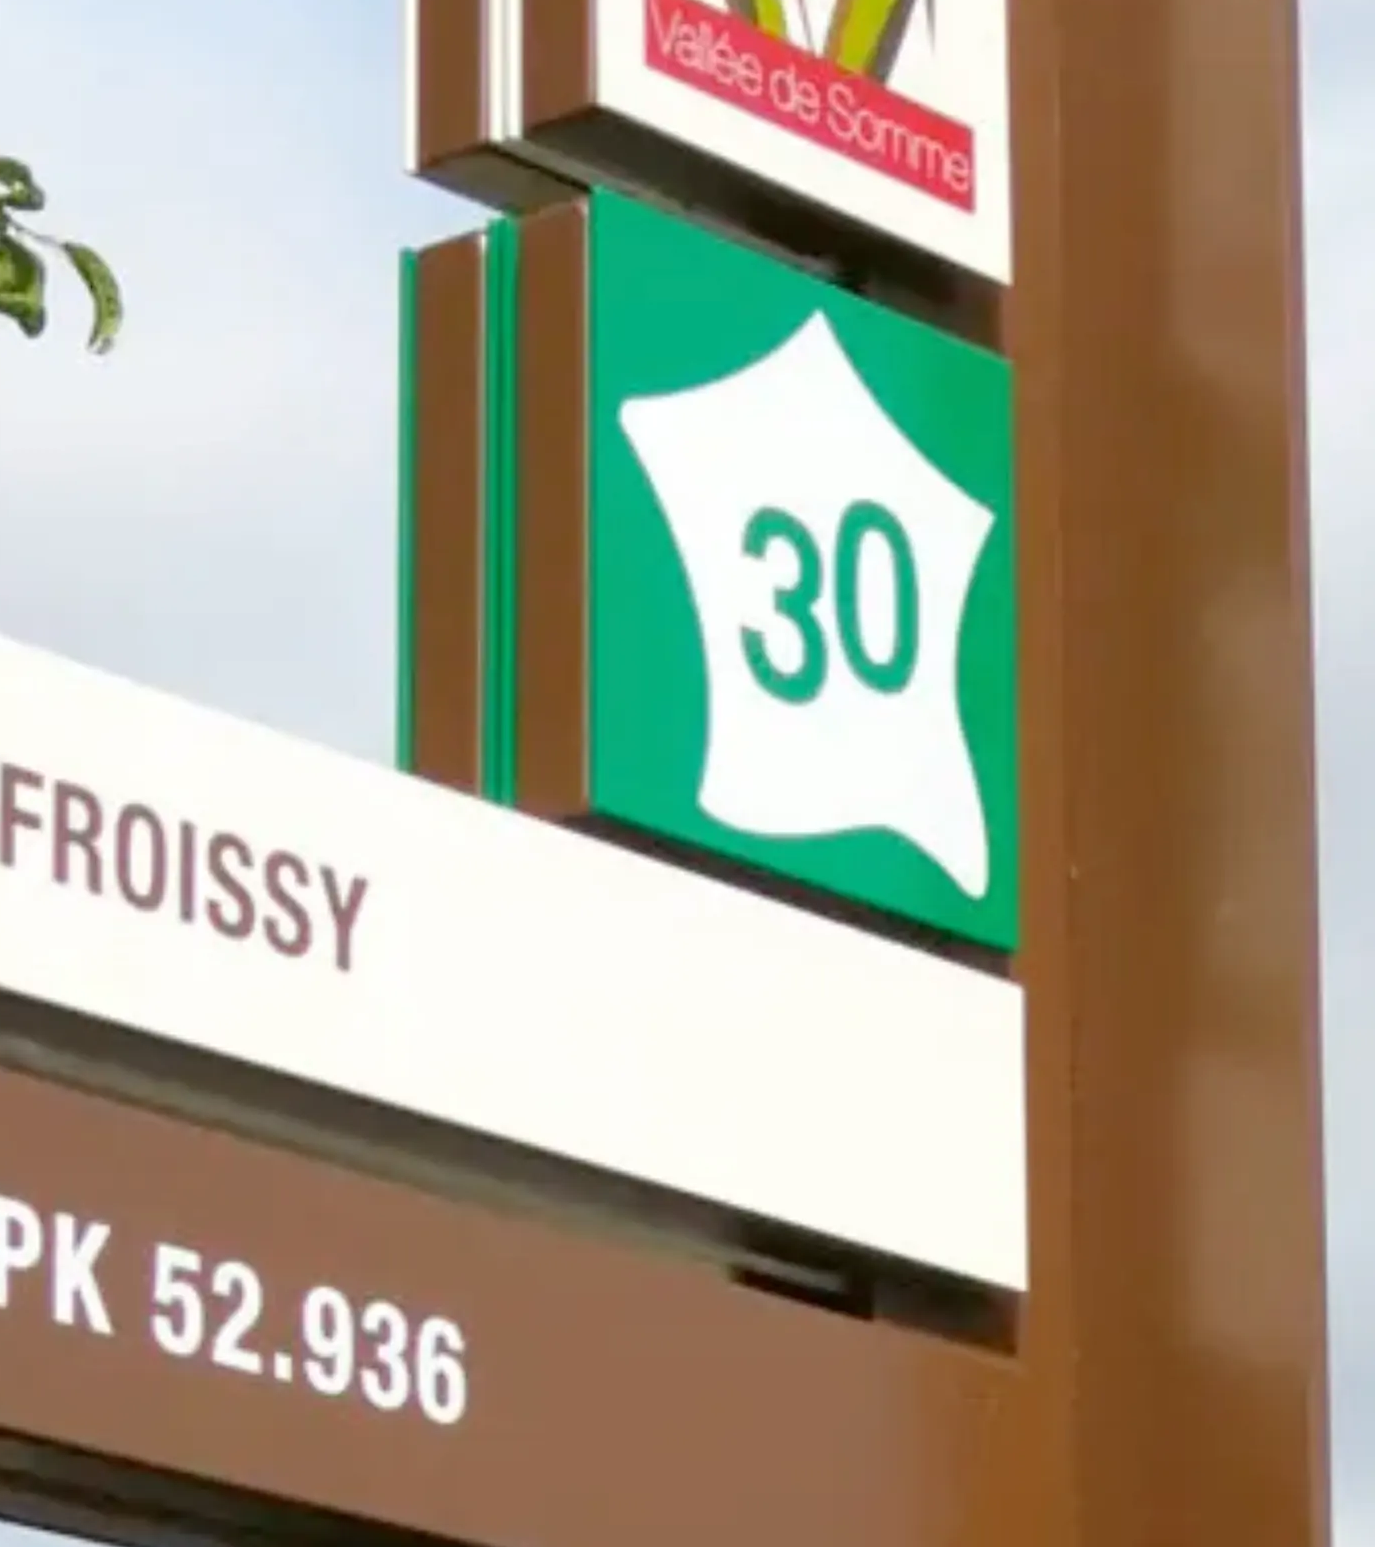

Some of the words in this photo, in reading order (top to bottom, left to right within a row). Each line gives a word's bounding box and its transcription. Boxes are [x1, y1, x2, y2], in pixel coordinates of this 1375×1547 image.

[770, 65, 820, 124] de
[826, 83, 970, 193] Somme
[741, 499, 921, 705] 30
[0, 763, 368, 973] FROISSY
[153, 1245, 467, 1425] 52.936
